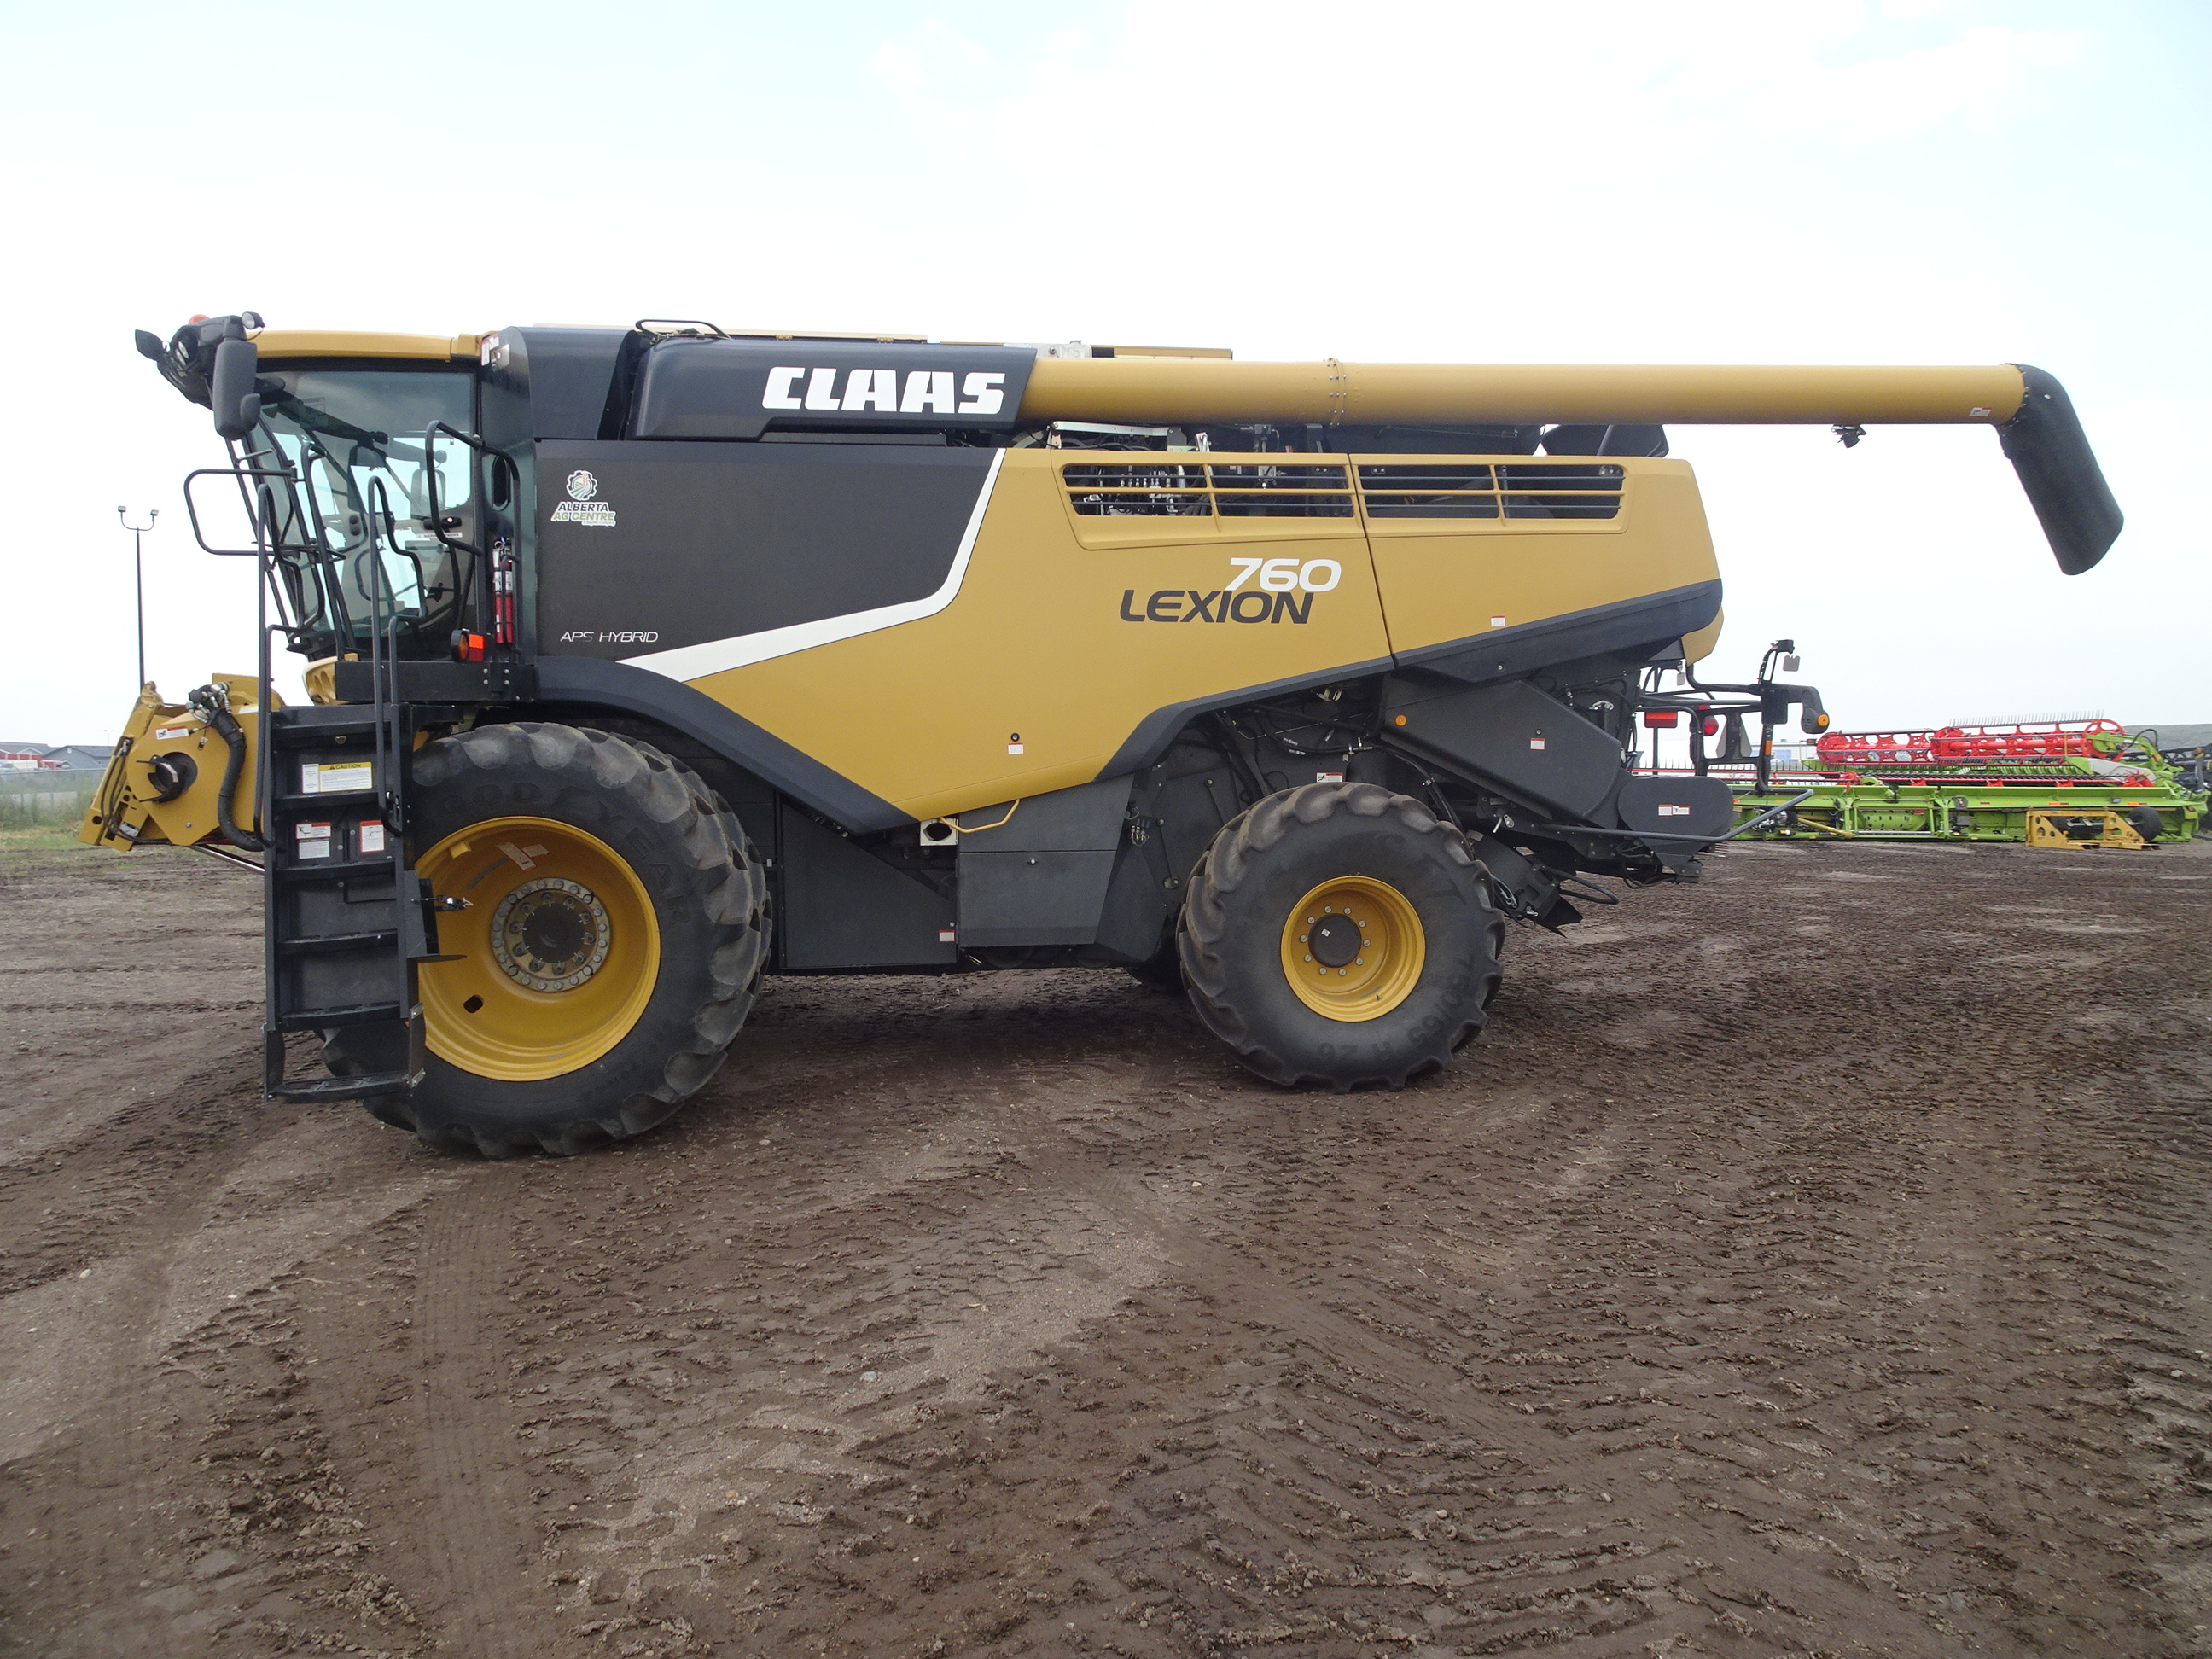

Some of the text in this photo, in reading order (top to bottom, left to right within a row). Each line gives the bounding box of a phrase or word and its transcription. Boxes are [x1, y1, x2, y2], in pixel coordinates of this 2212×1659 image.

[762, 366, 1006, 415] CLAAS
[553, 512, 614, 521] AG CENTRE
[558, 503, 608, 511] ALBERTA
[1225, 557, 1342, 592] 760
[1120, 589, 1314, 624] LEXION
[560, 631, 659, 643] APS HYBRID
[427, 782, 696, 923] OODYEAR
